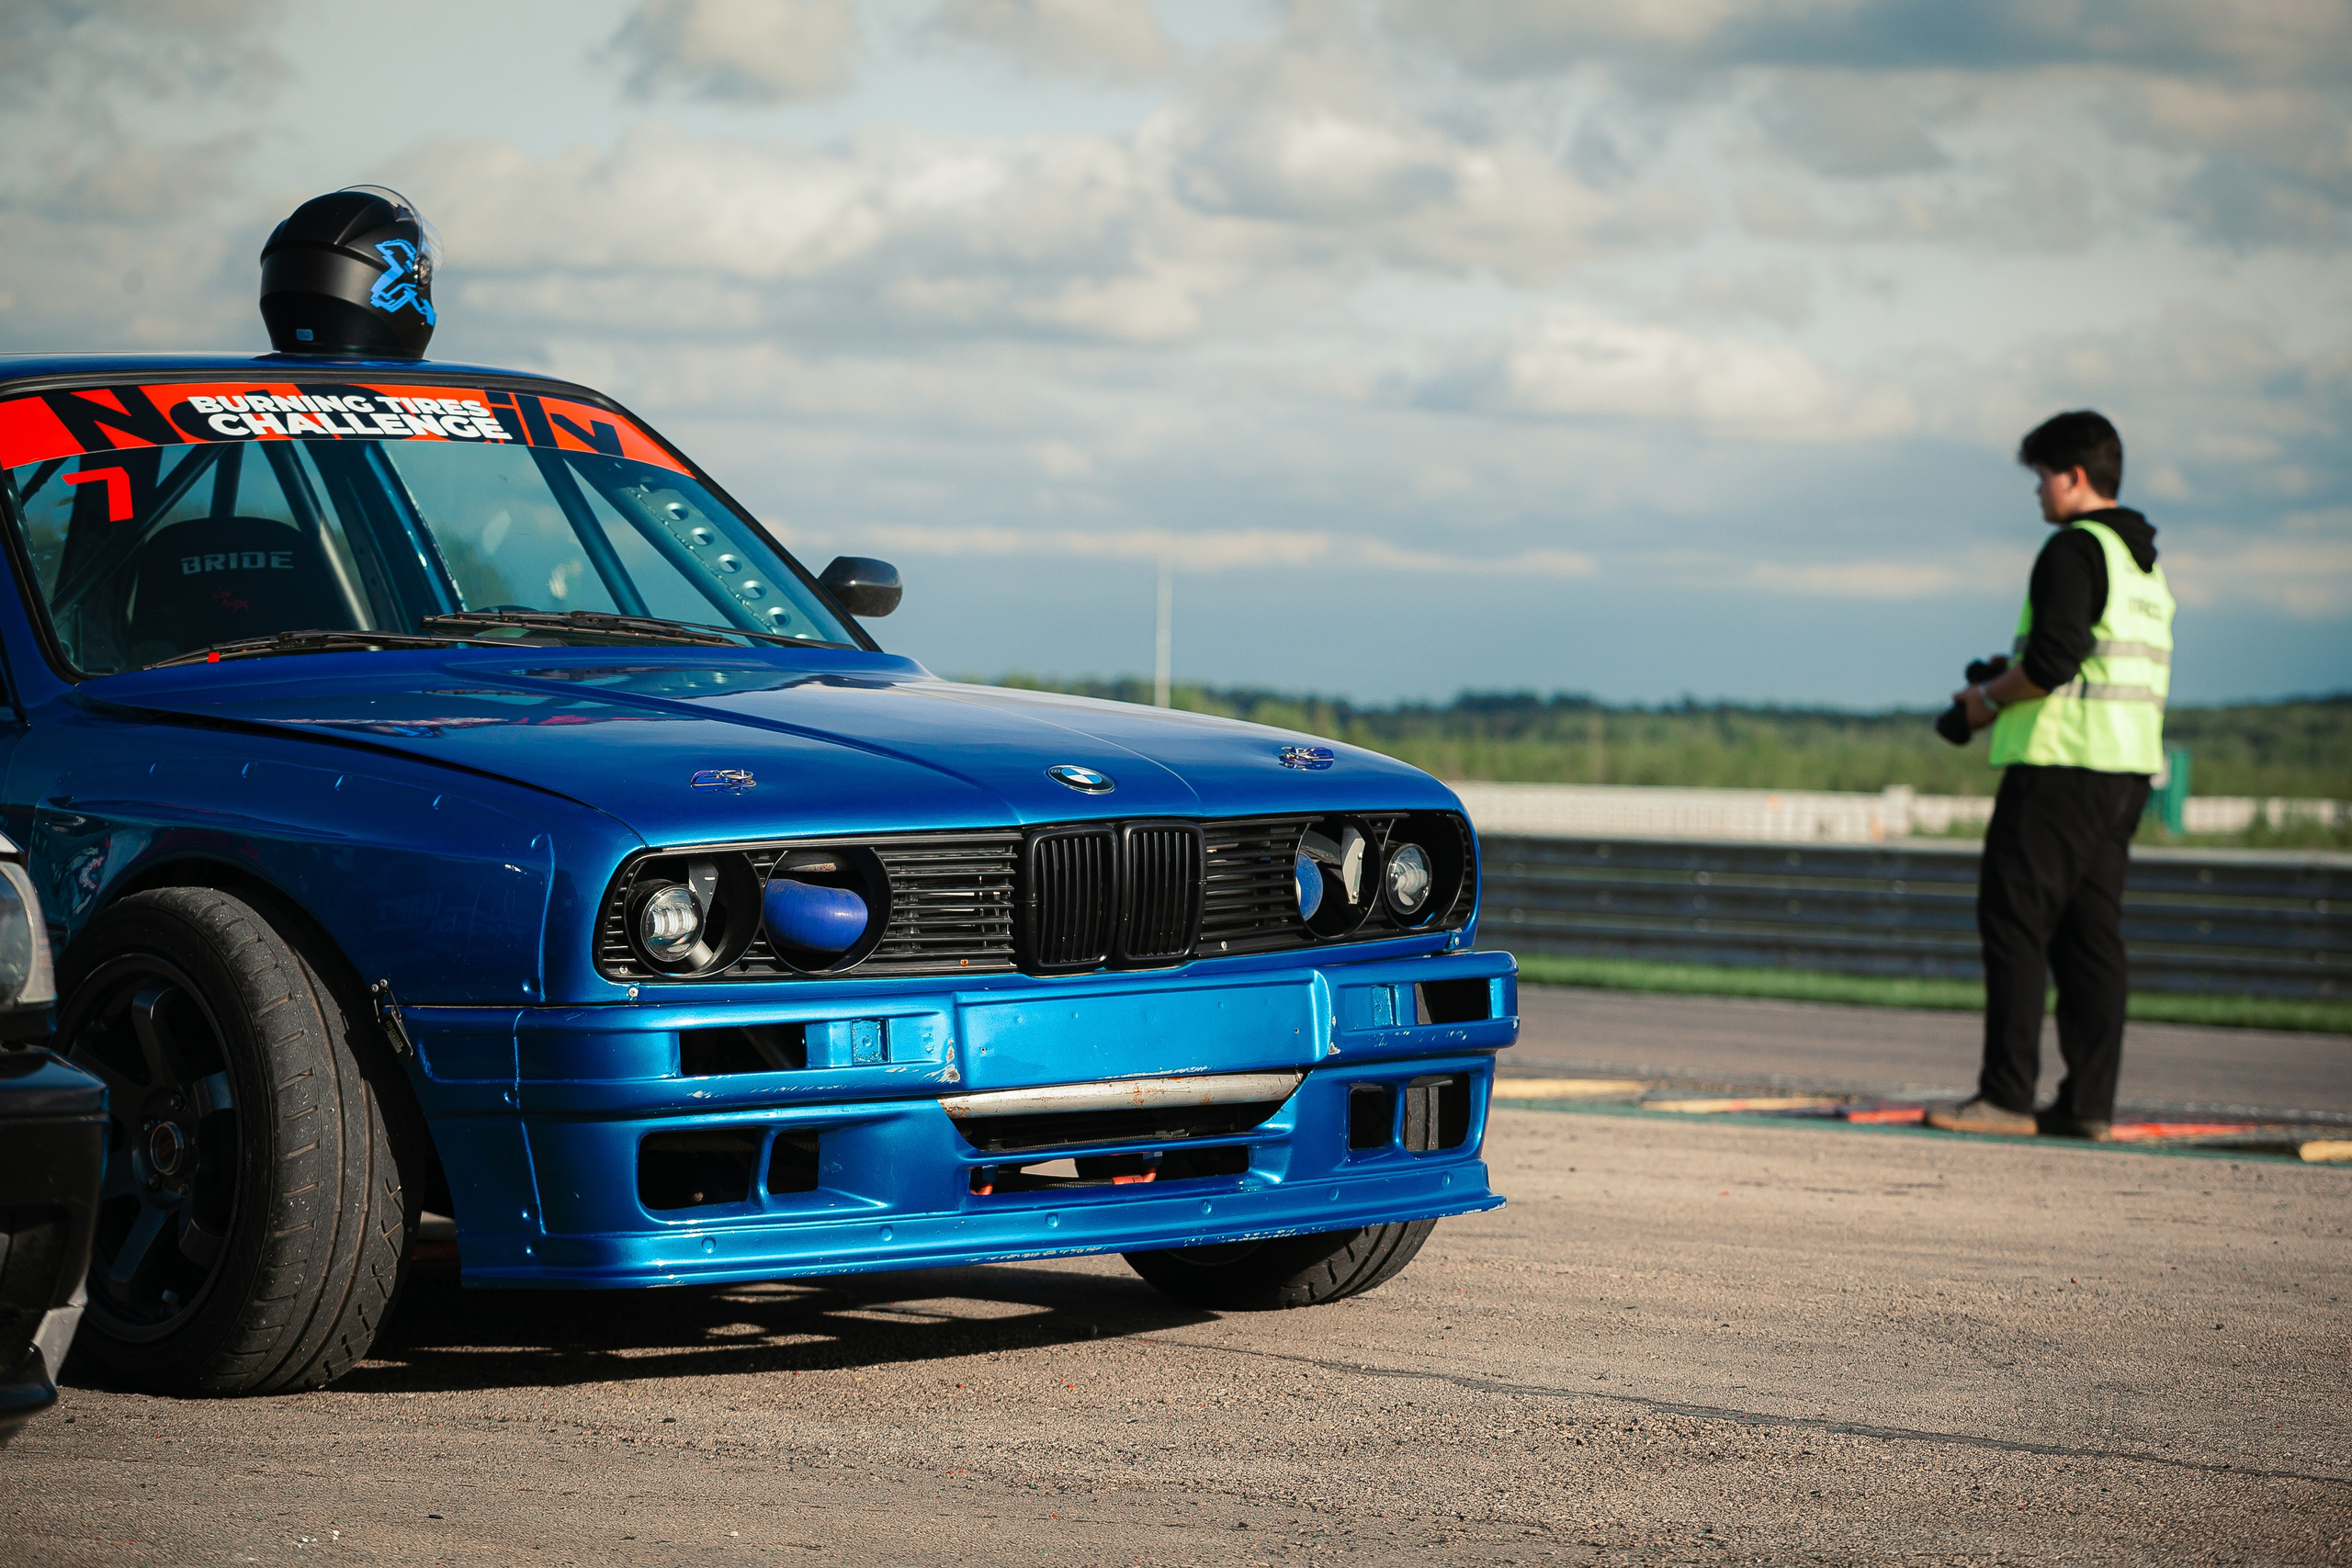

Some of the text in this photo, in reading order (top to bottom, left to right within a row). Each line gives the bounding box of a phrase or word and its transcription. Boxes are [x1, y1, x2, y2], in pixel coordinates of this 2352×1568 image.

[187, 395, 491, 417] BURNING TIRES
[208, 413, 514, 440] CHALLENGE
[180, 551, 294, 575] BRIDE
